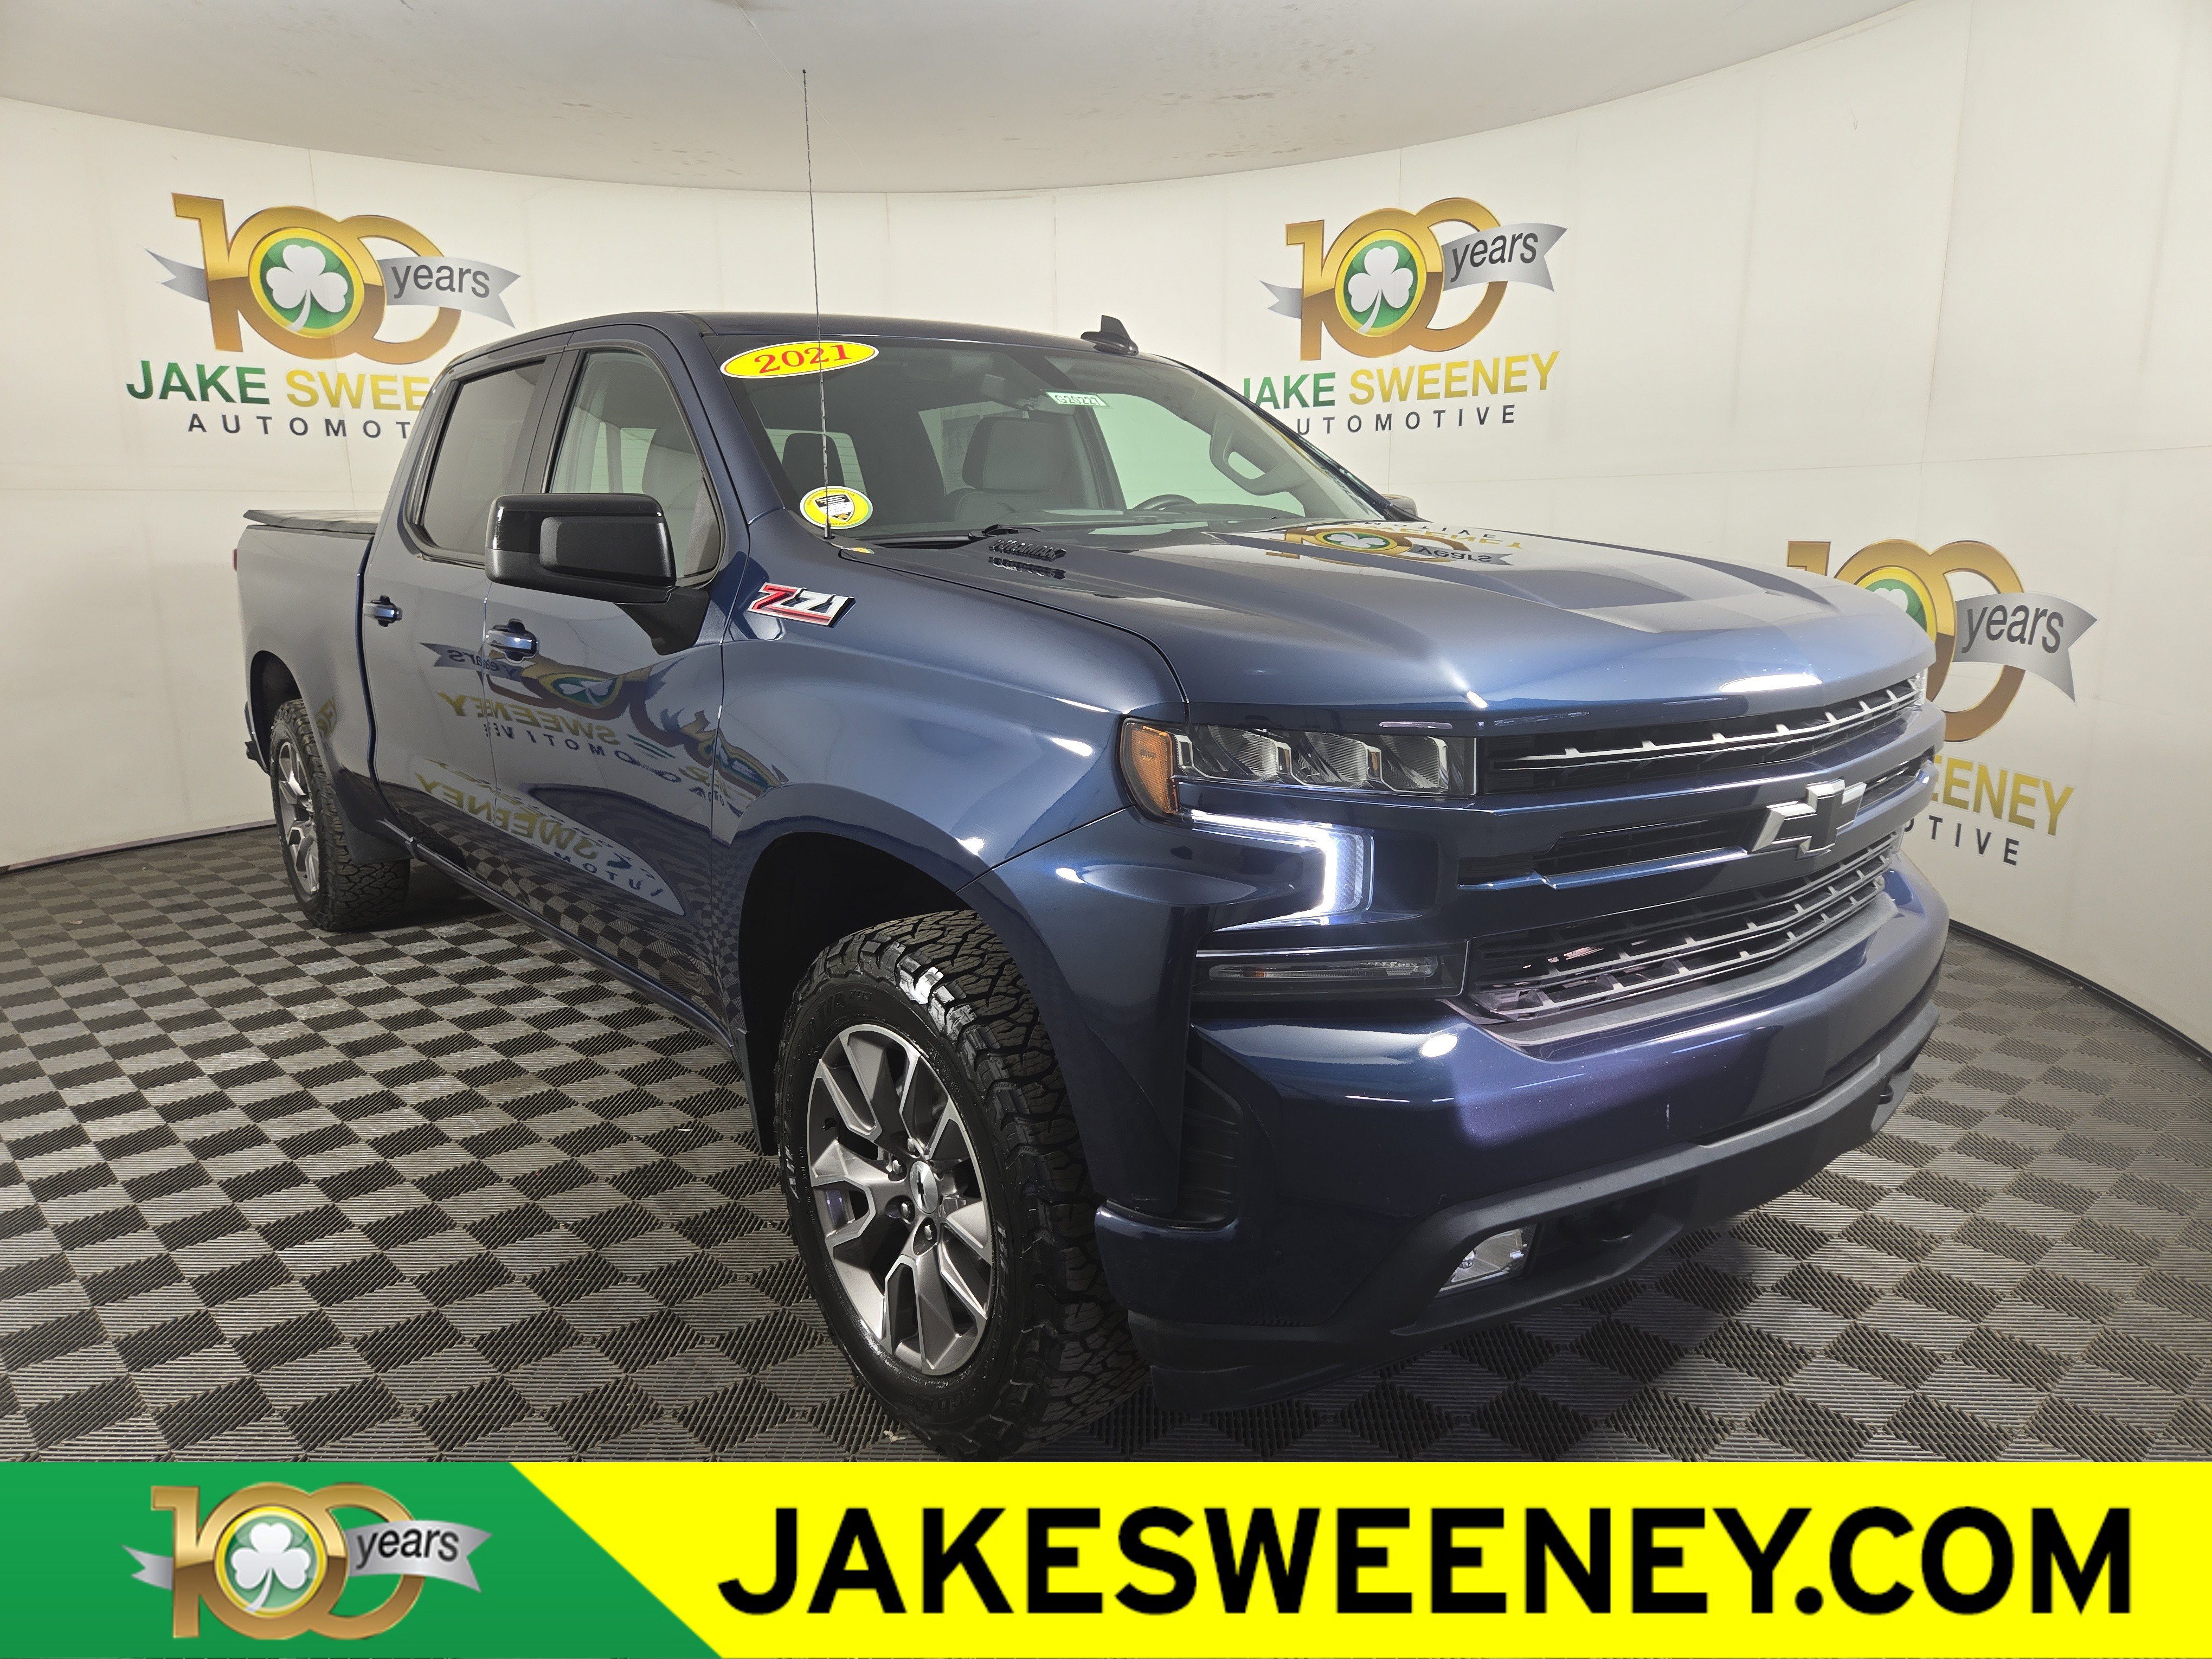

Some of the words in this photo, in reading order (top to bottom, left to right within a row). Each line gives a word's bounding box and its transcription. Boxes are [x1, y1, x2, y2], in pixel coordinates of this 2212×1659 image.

[171, 192, 461, 365] 100
[391, 264, 490, 298] years
[1285, 197, 1508, 361] 100
[1450, 232, 1538, 282] years
[754, 345, 852, 374] 2021
[1349, 351, 1560, 406] SWEENEY
[126, 360, 270, 405] JAKE
[285, 369, 429, 411] SWEE
[1054, 395, 1100, 405] G20227
[188, 413, 410, 439] AUTOMOT
[1297, 404, 1516, 435] UTOMOTIVE
[747, 582, 857, 628] Z71
[1962, 604, 2064, 654] years
[1931, 755, 2075, 837] ENEY
